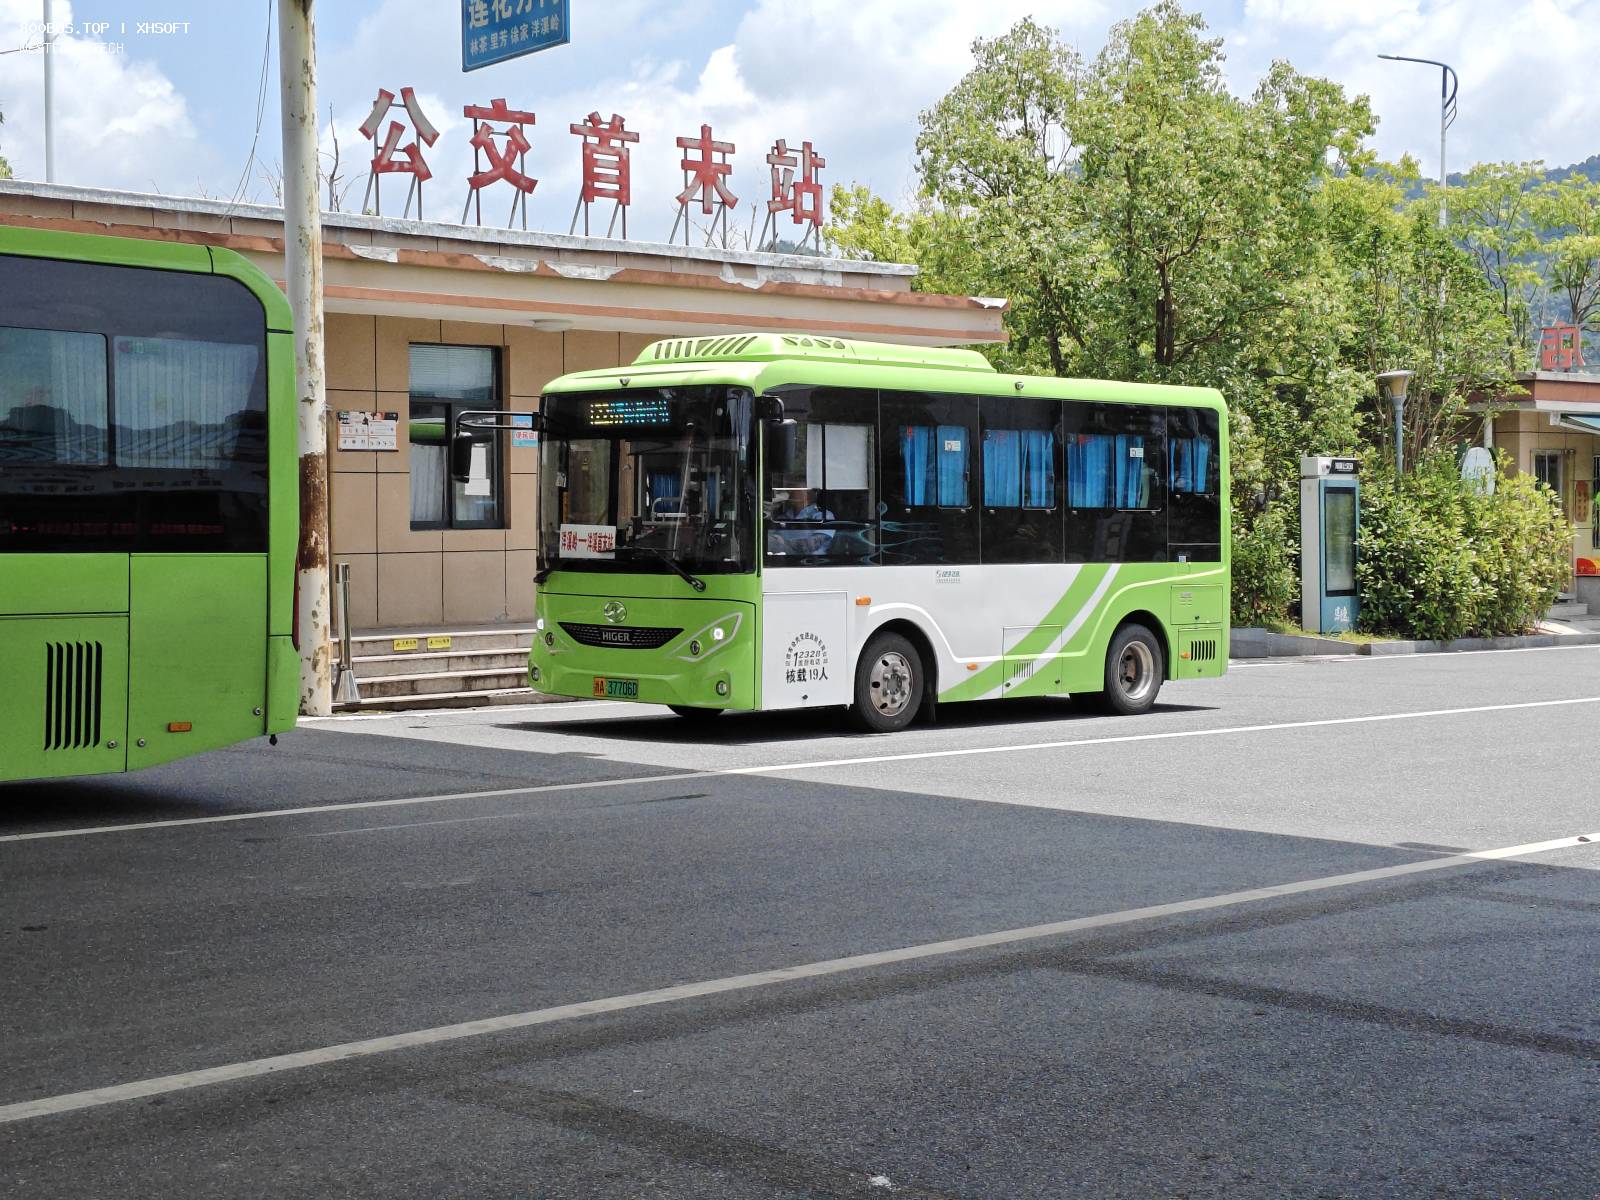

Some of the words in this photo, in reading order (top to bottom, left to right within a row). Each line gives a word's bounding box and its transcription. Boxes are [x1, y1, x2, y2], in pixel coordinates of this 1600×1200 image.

[359, 86, 825, 226] 公交首末站
[602, 631, 630, 642] HIGER
